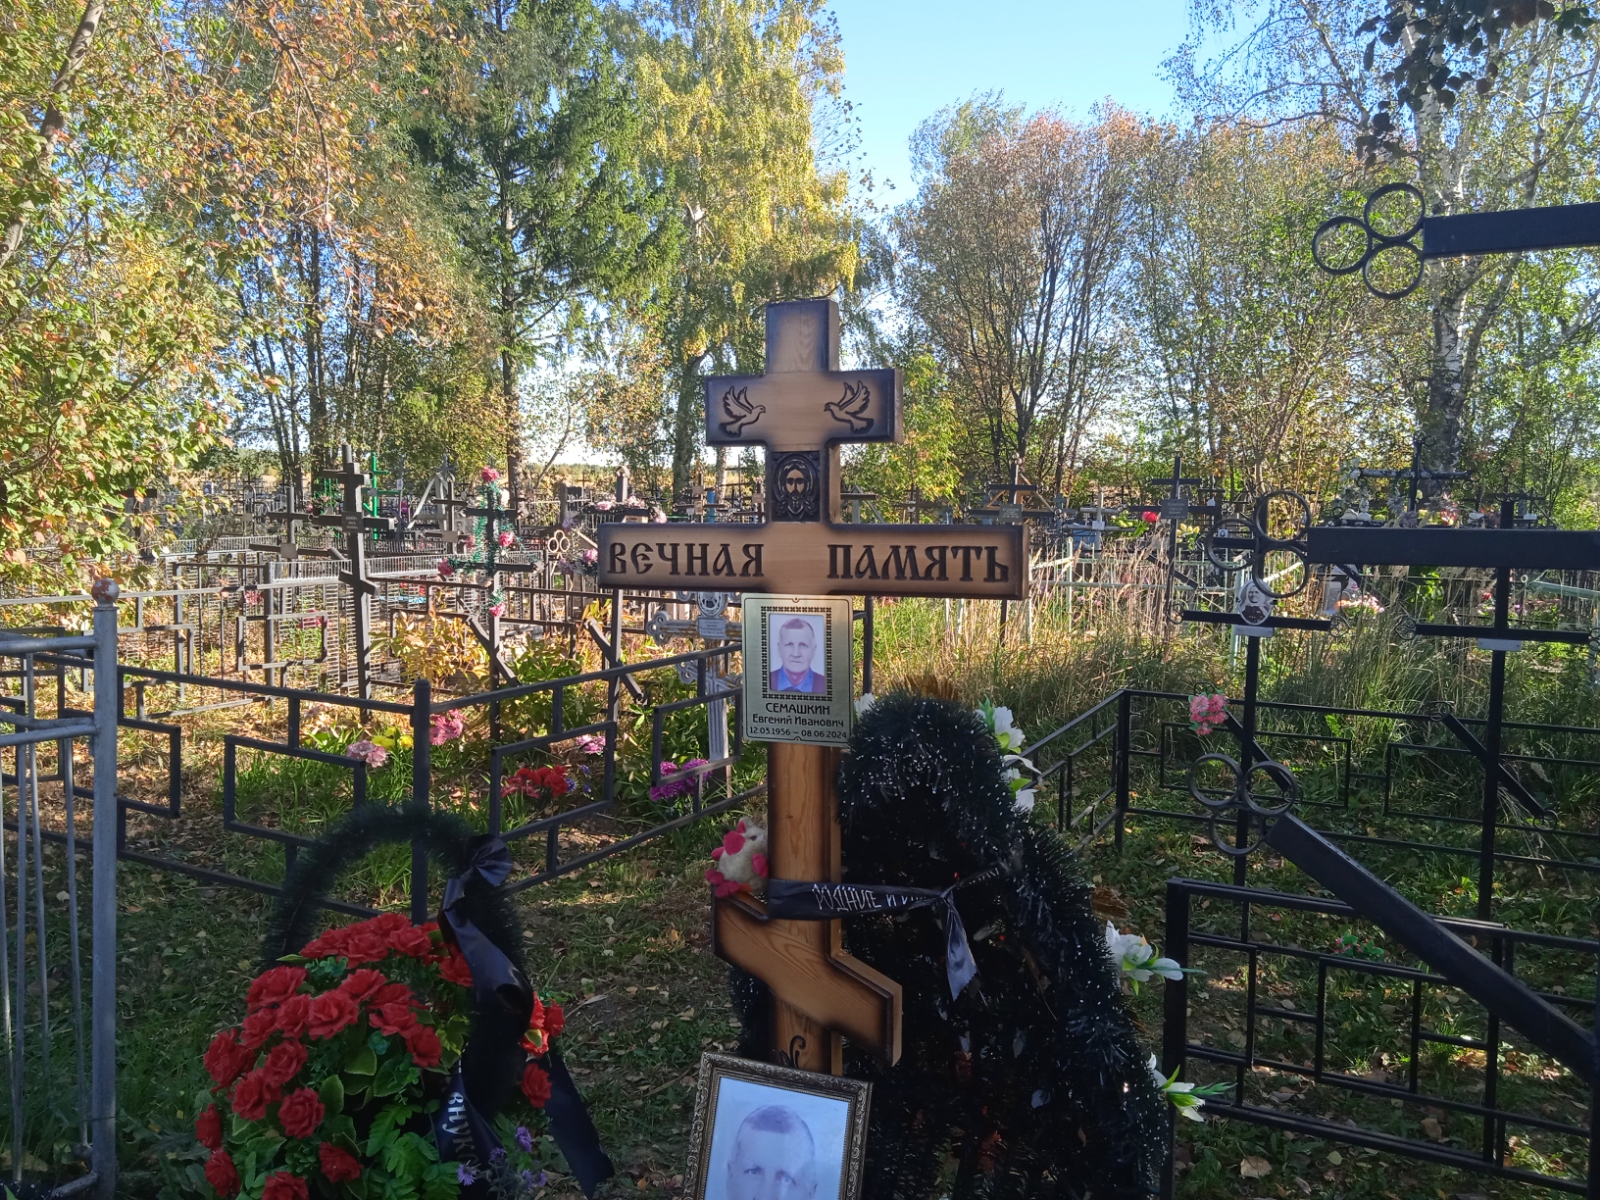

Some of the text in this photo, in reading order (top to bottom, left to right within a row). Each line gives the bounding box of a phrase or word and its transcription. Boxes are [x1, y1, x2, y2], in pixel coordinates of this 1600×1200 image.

[607, 542, 1009, 583] ВЕЧНАЯ ПАМЯТЬ
[765, 702, 831, 716] СЕМАШКИН
[752, 713, 844, 727] Евгений Иванович
